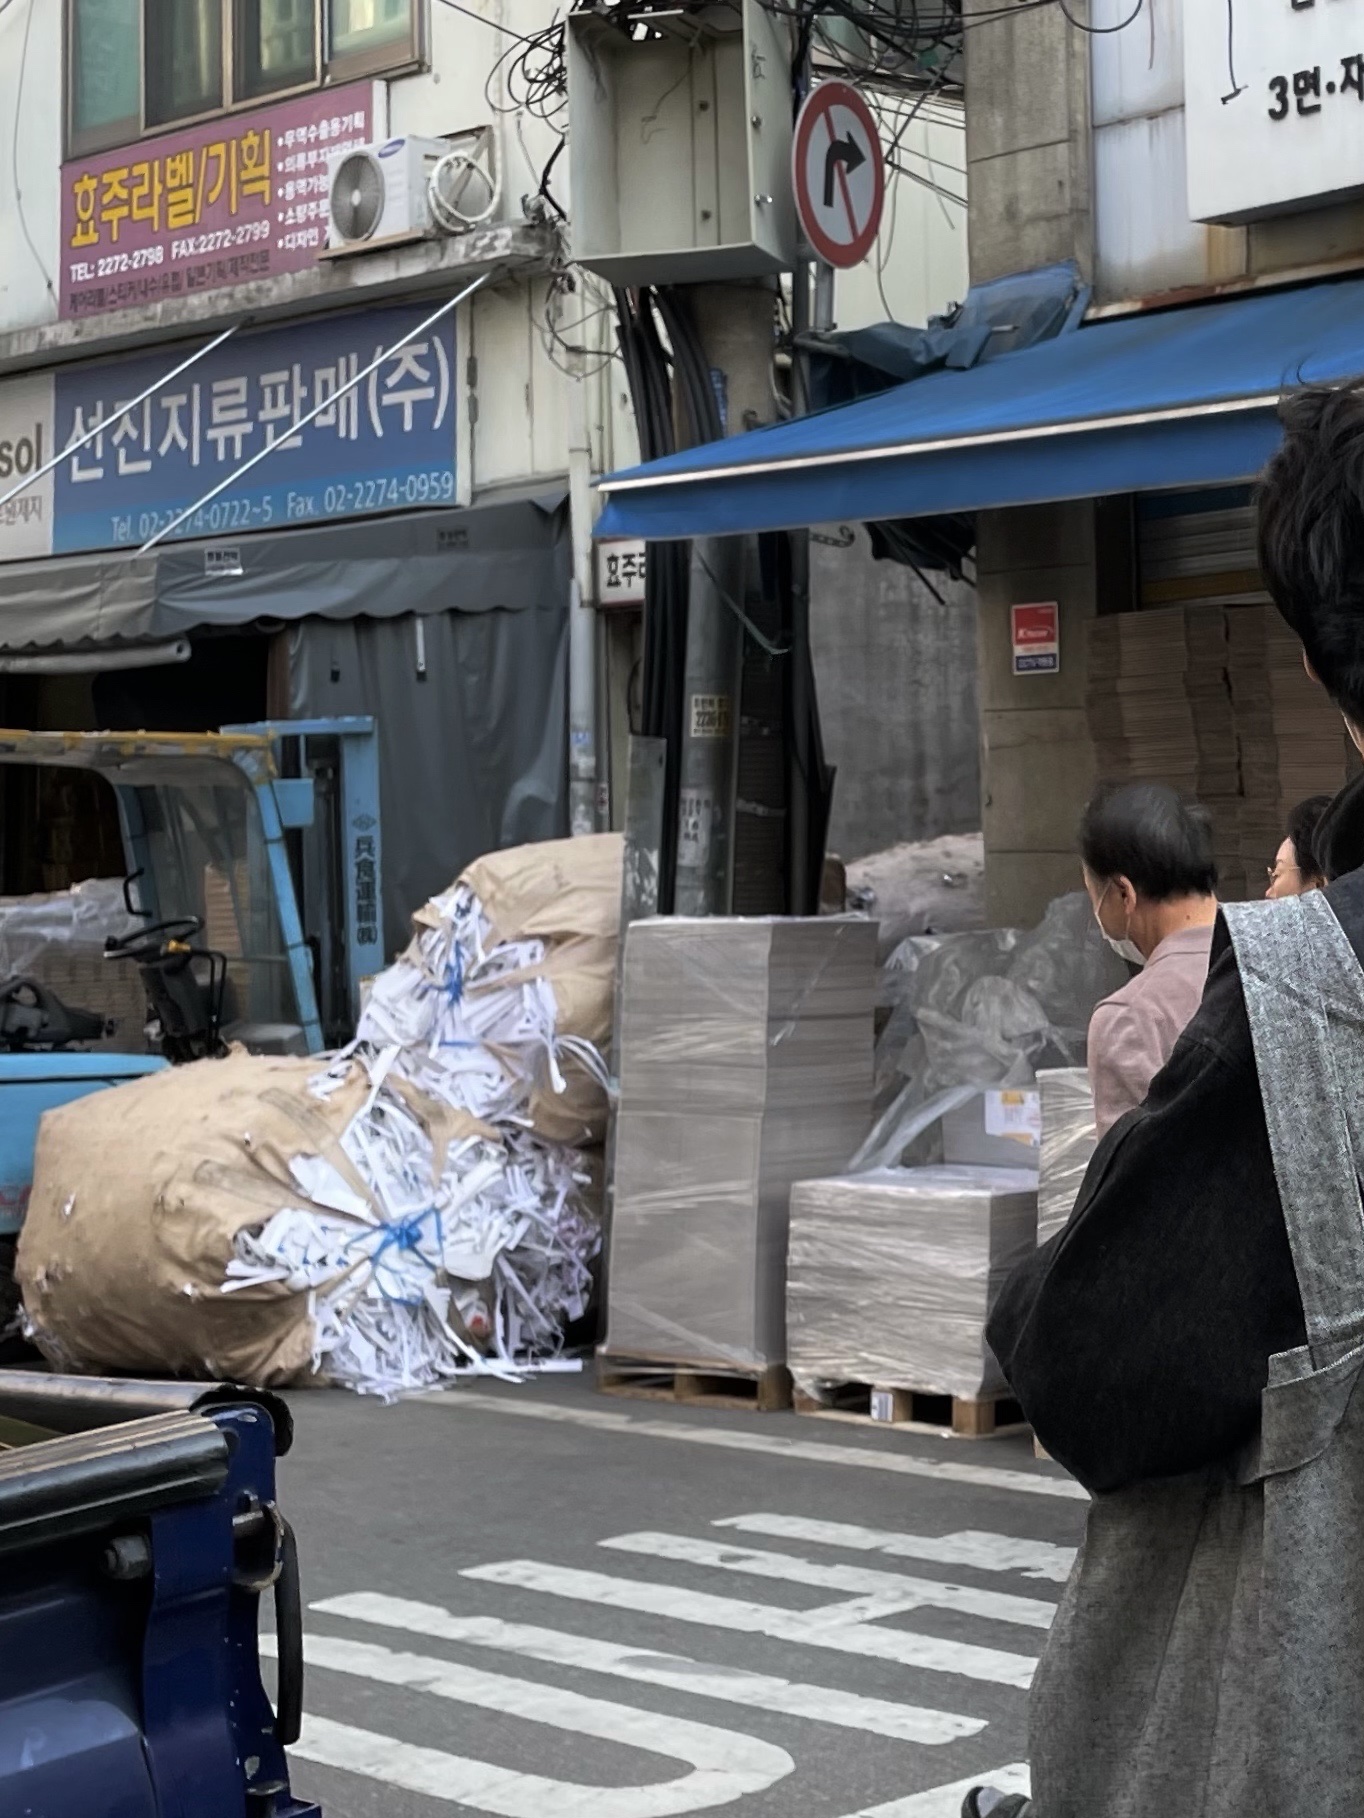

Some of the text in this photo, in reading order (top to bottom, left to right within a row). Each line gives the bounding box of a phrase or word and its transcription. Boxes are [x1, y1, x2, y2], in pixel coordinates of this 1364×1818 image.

[71, 129, 271, 247] 효주라벨/기획
[70, 262, 95, 283] TEL:
[324, 471, 454, 513] 02-2274-0959
